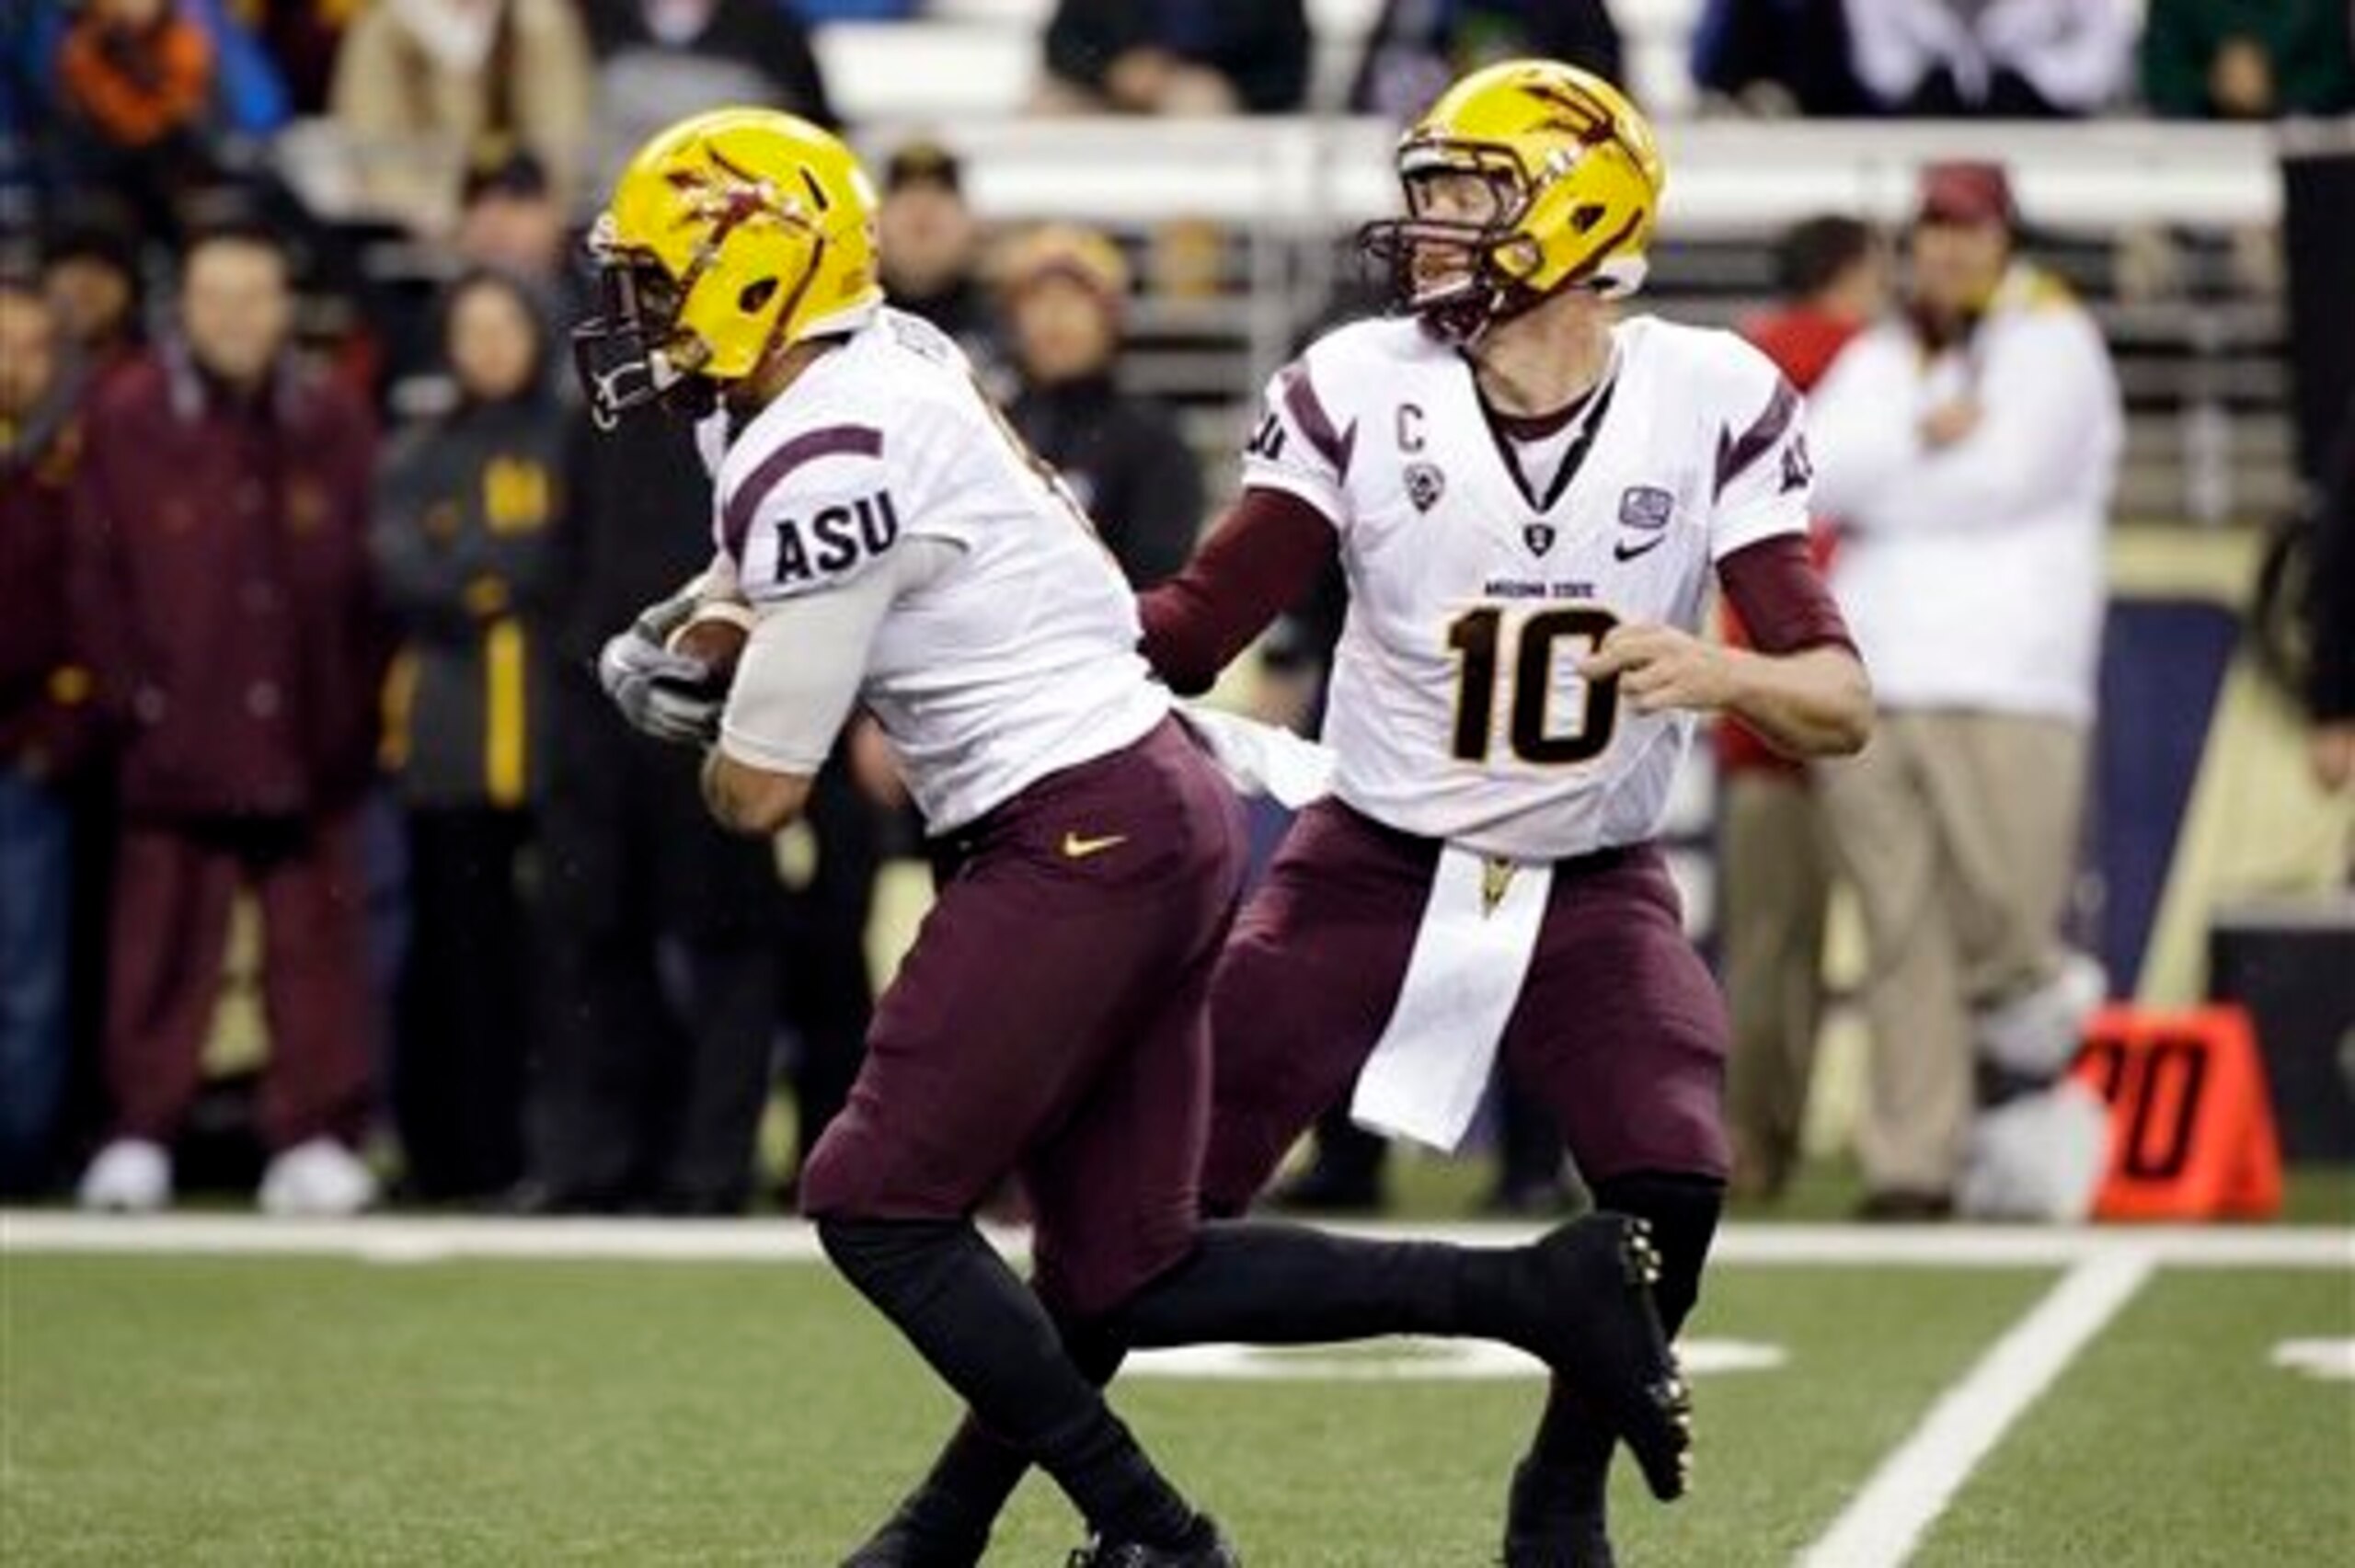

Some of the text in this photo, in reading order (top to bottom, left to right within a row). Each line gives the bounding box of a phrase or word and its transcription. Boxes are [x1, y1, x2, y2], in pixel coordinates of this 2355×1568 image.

[1396, 403, 1425, 454] C
[774, 489, 899, 584] ASU
[1552, 581, 1594, 598] STATE
[1448, 606, 1622, 765] 10
